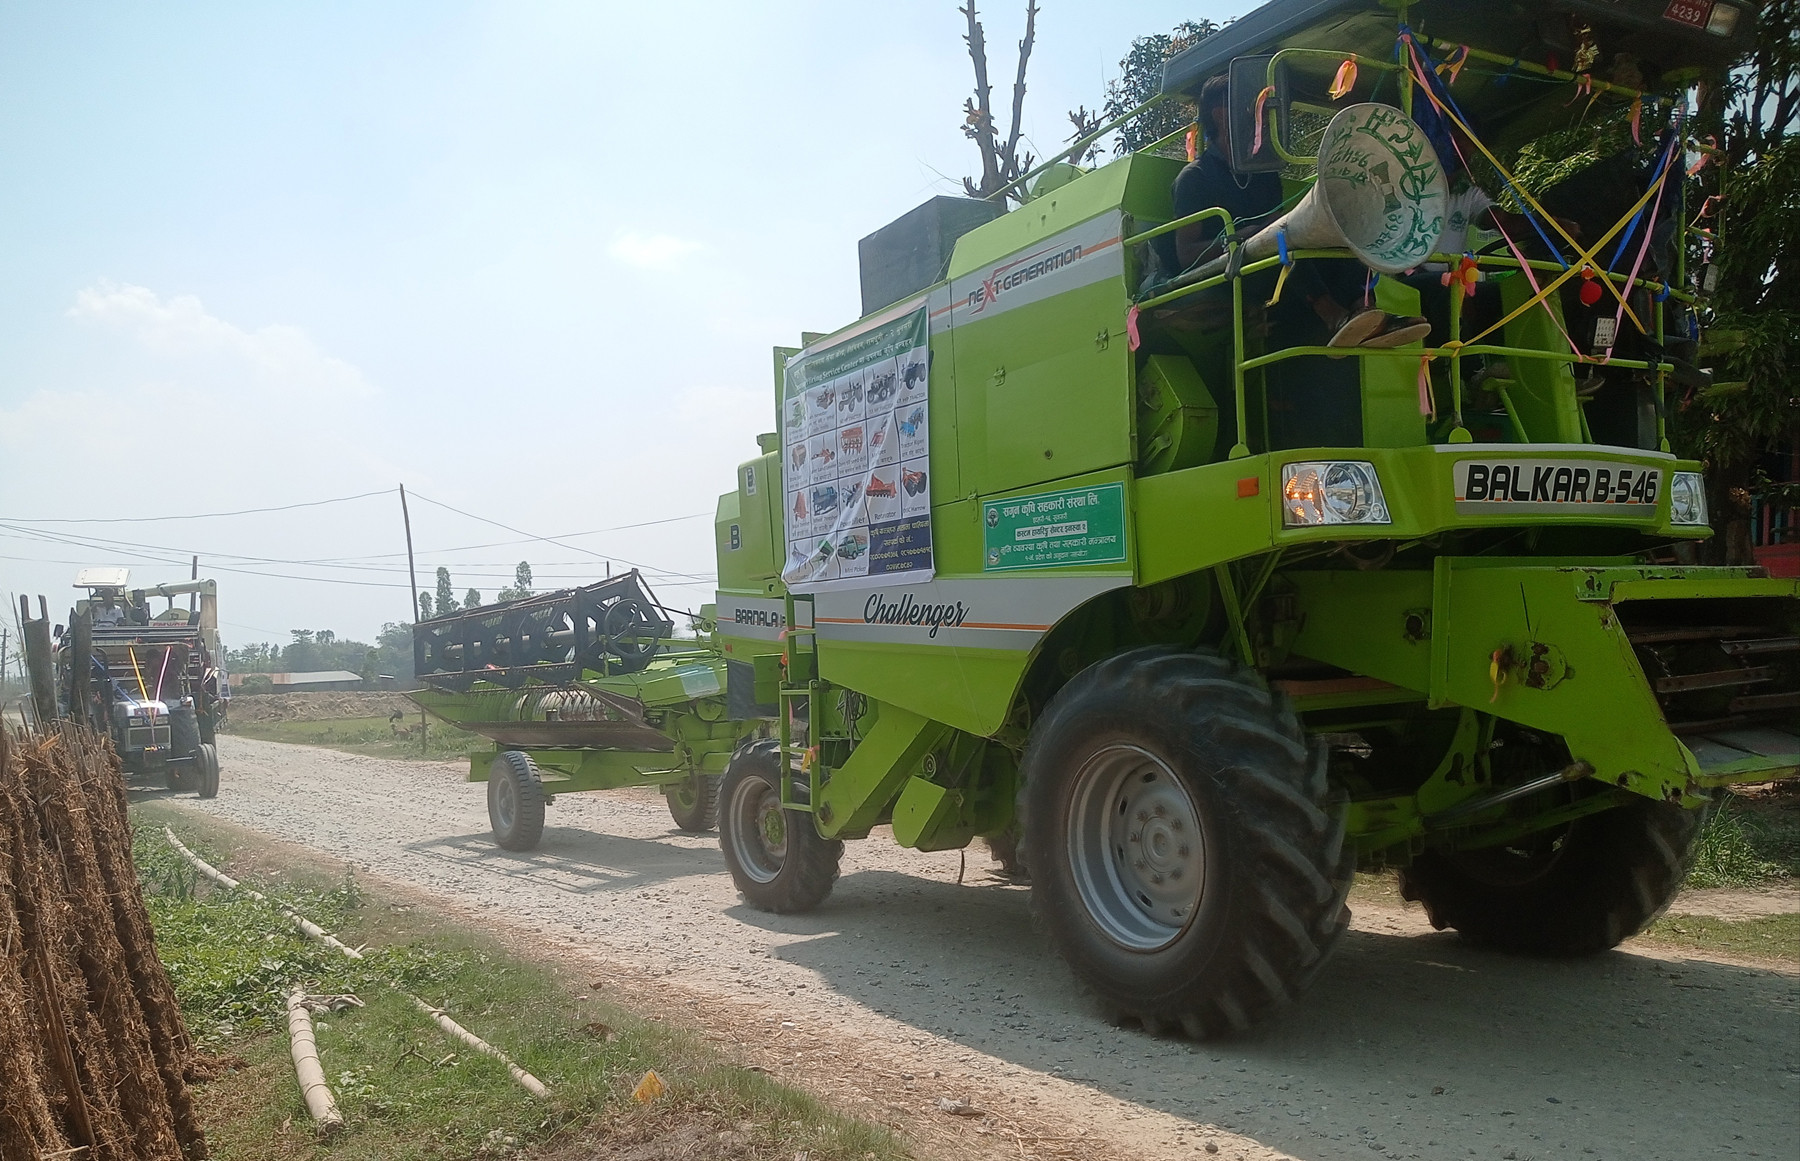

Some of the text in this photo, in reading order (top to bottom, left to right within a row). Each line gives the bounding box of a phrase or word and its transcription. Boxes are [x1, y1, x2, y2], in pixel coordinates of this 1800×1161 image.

[823, 367, 841, 379] Service
[841, 359, 859, 373] Center
[1466, 464, 1659, 504] BALKAR B-546
[1021, 501, 1036, 516] कृषि
[1037, 496, 1065, 513] सहकारी
[1066, 496, 1086, 509] संस्था
[735, 608, 778, 628] BARNALA
[864, 593, 970, 639] Challenger
